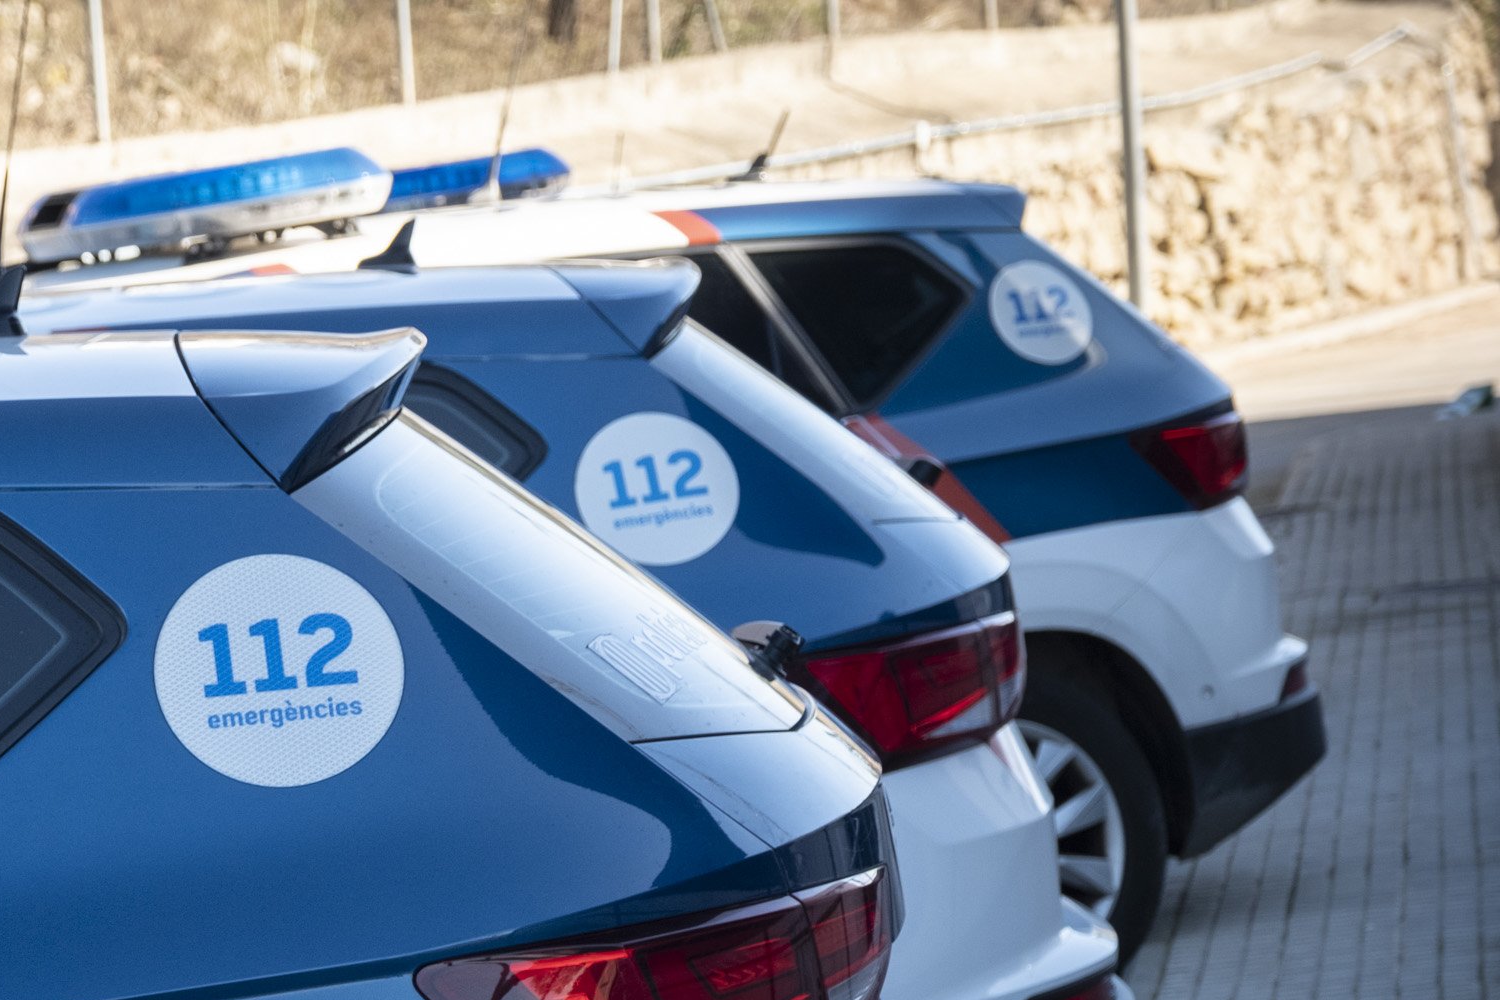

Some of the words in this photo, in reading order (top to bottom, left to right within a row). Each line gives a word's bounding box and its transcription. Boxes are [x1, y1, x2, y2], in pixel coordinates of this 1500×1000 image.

[602, 448, 709, 508] 112
[198, 612, 359, 698] 112
[207, 697, 363, 729] emergències
